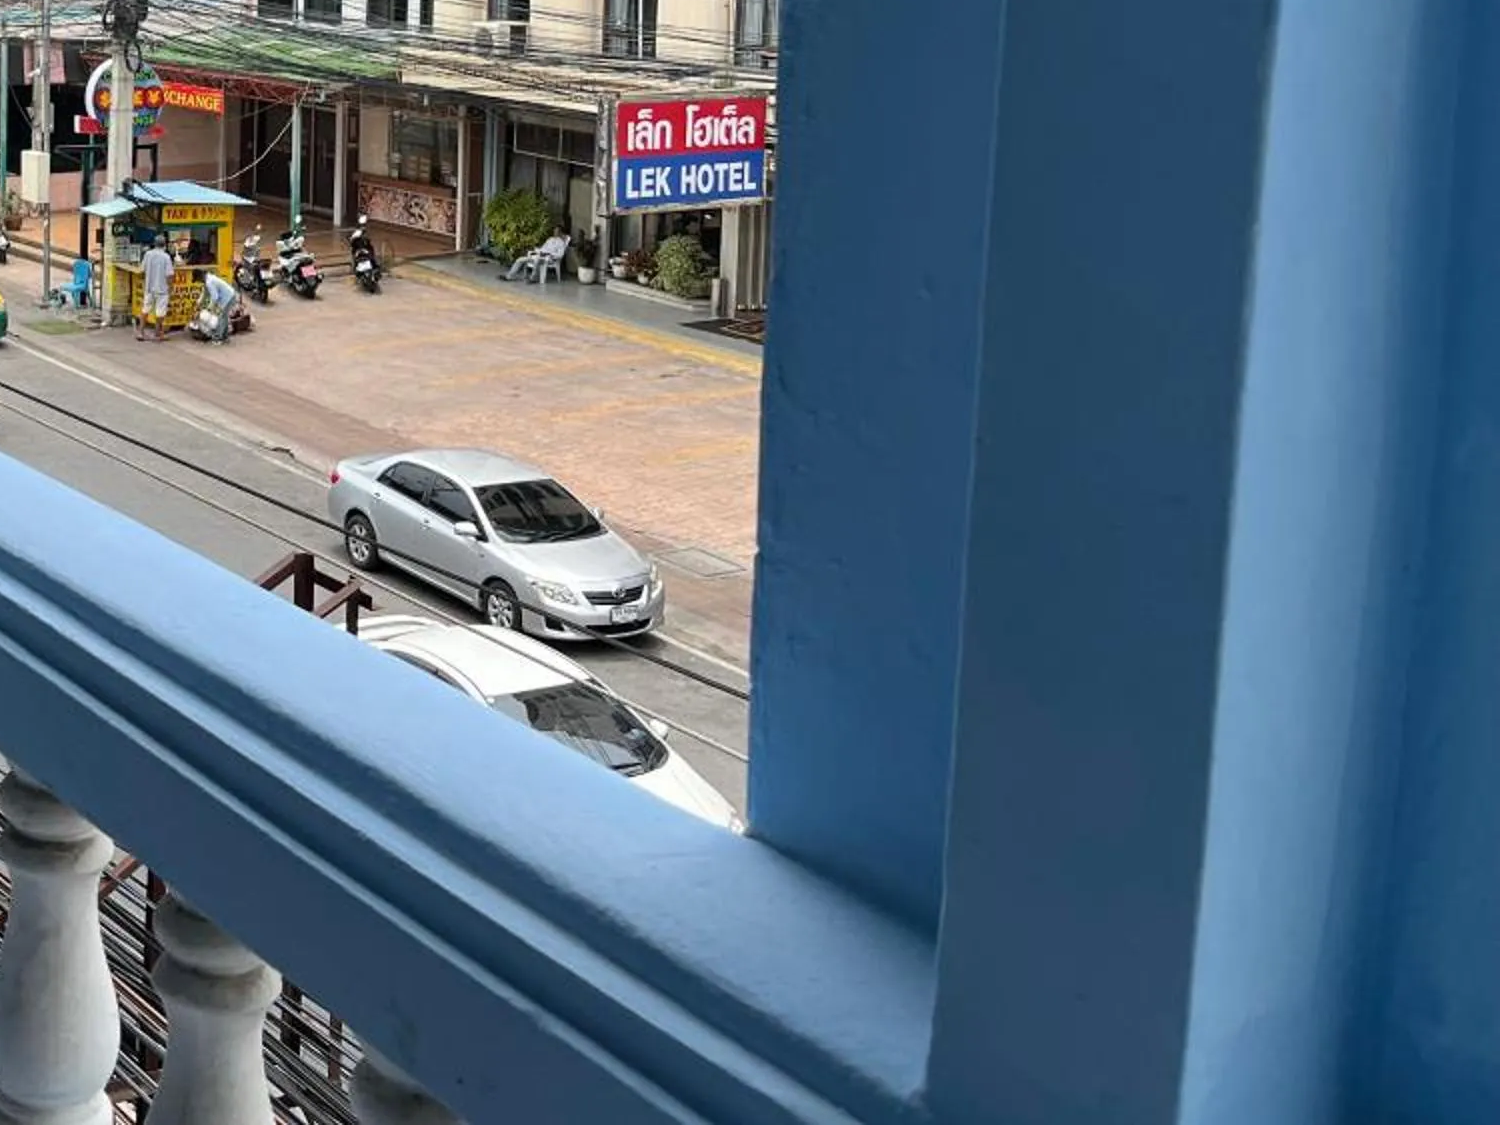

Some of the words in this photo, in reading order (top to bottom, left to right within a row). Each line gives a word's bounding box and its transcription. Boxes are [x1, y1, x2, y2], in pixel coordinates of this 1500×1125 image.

[627, 108, 672, 151] เล็ก
[686, 105, 756, 148] โฮเต็ล
[626, 166, 671, 199] LEK
[681, 161, 757, 195] HOTEL
[166, 208, 188, 220] TAXI
